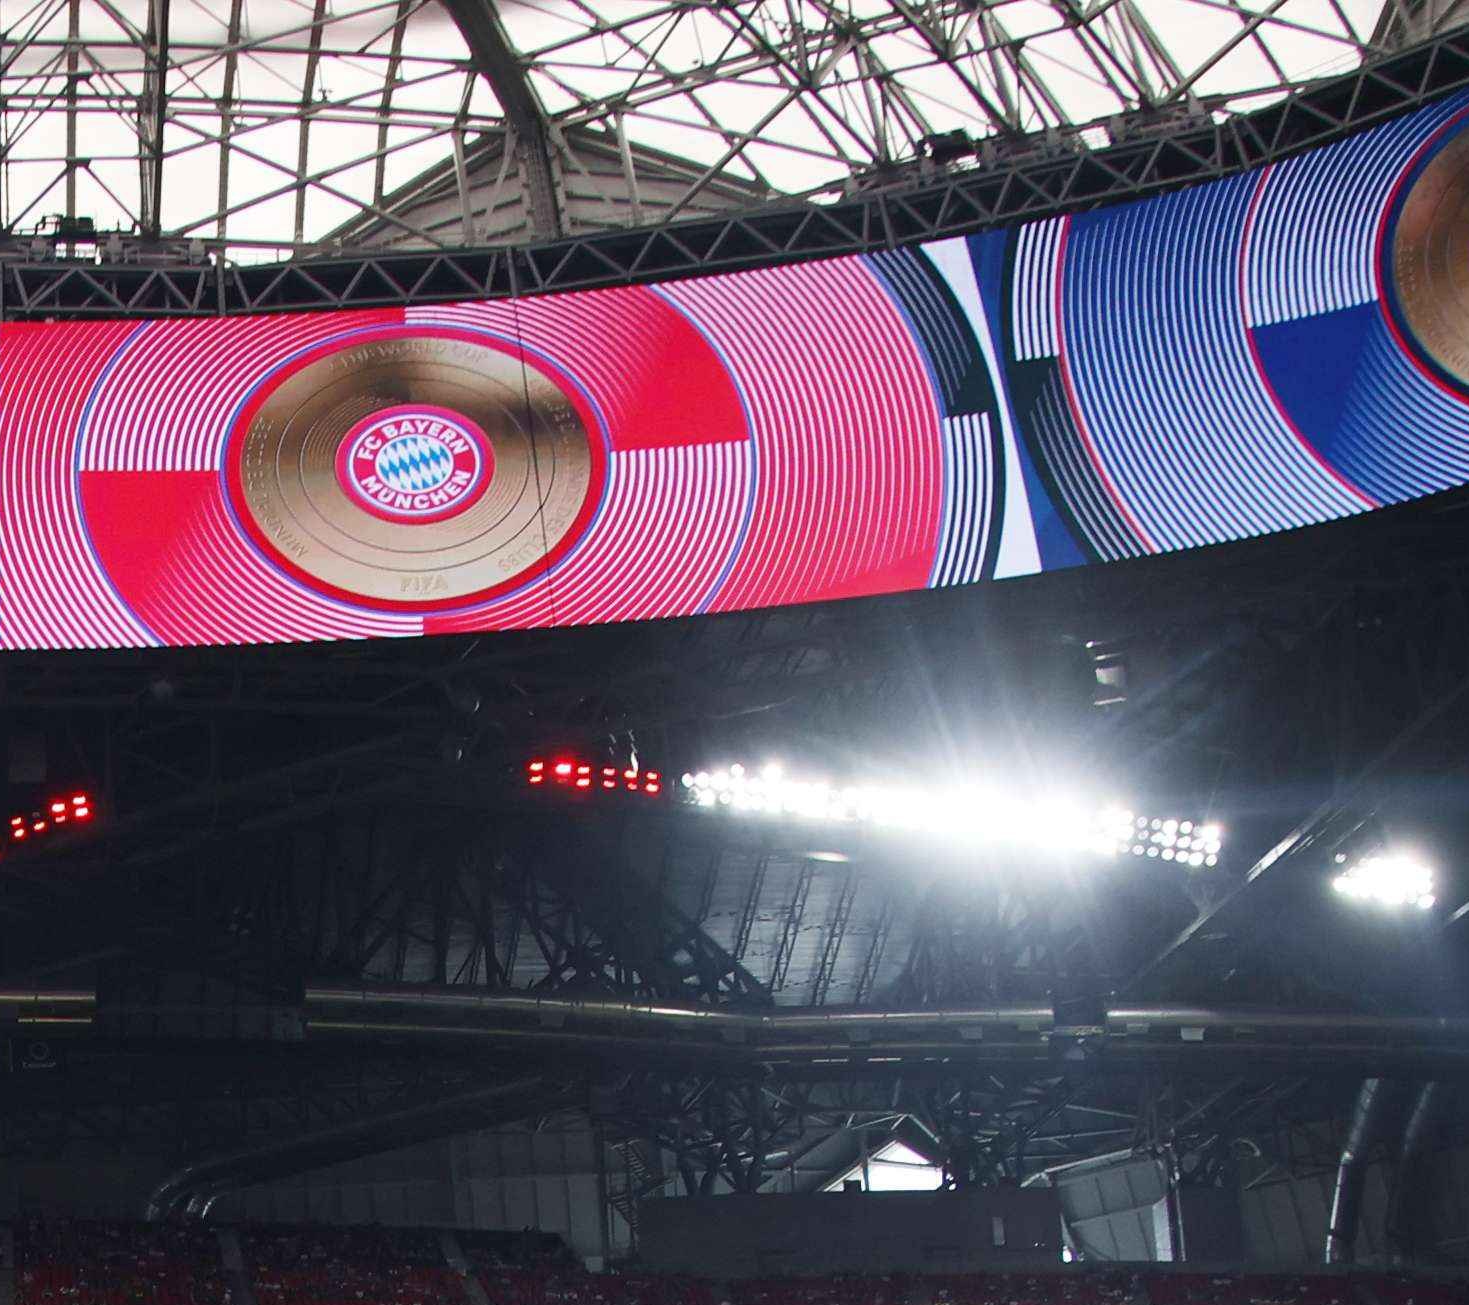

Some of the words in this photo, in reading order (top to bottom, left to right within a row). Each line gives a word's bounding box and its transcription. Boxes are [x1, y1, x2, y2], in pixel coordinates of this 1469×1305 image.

[357, 434, 383, 460] FC
[386, 420, 470, 455] BAYERN
[361, 470, 471, 510] MÜNCHEN
